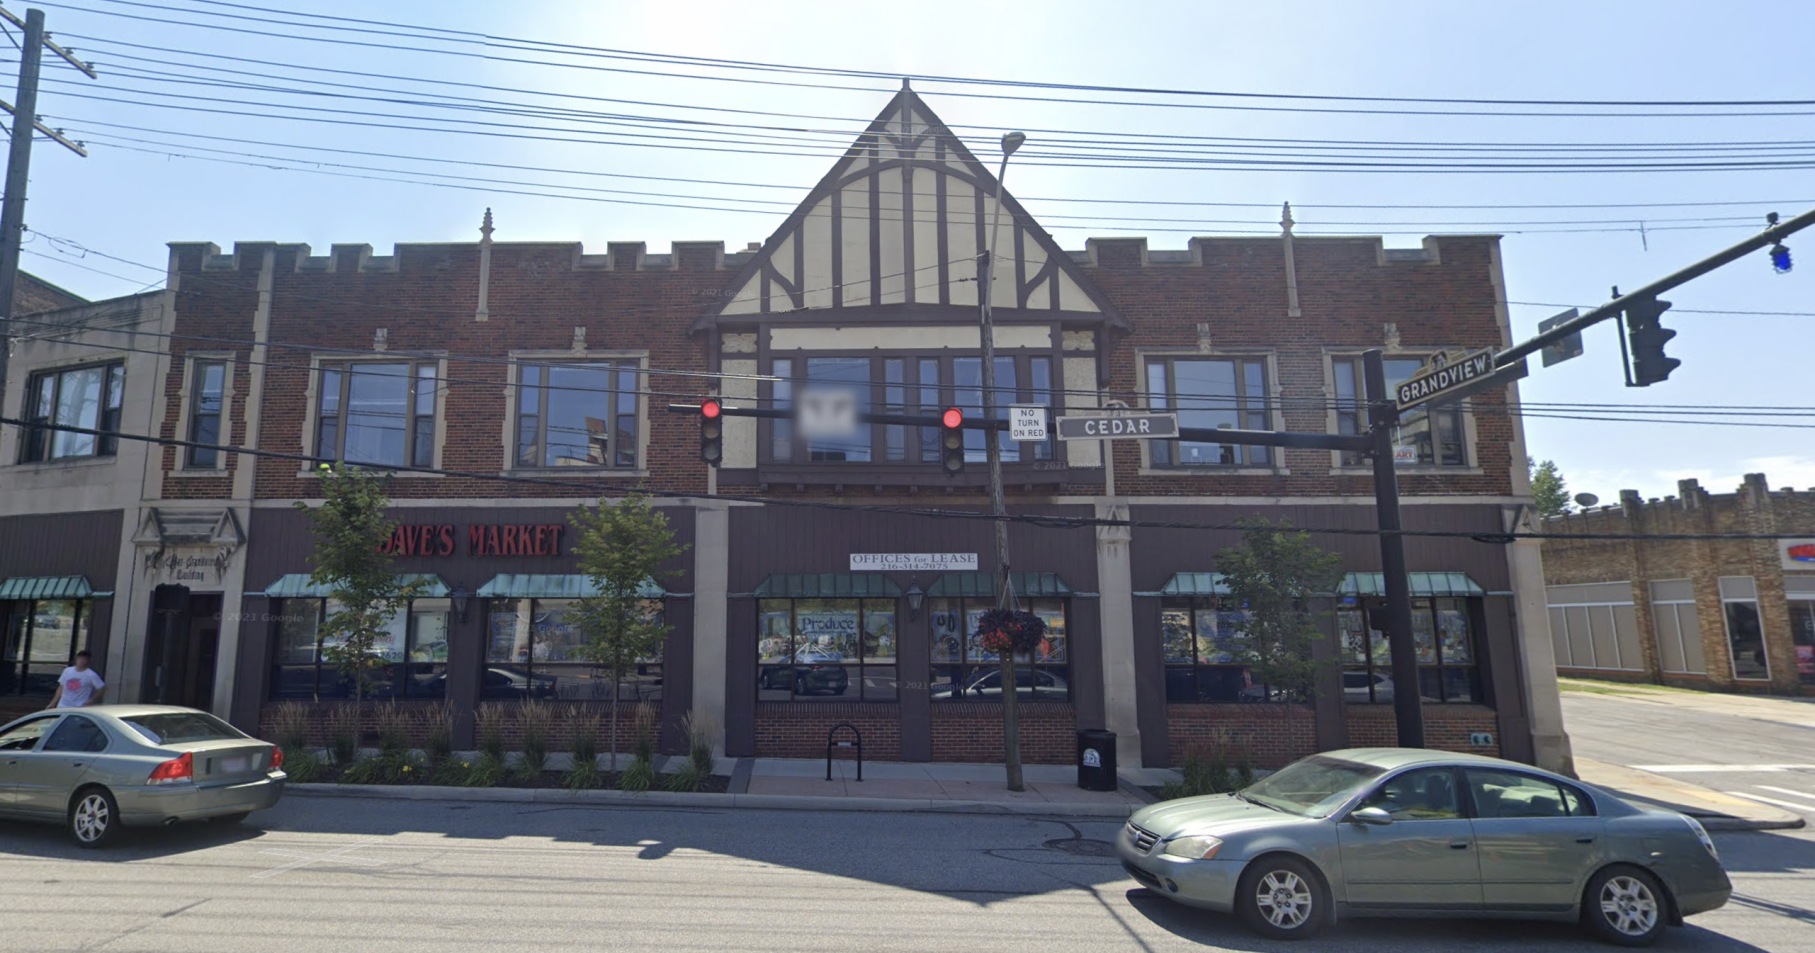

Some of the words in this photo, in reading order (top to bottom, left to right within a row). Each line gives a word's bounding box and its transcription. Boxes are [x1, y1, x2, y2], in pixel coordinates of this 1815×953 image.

[1401, 354, 1486, 402] GRANDVIEW
[1021, 409, 1035, 417] NO
[1018, 419, 1039, 427] TURN
[1085, 419, 1150, 435] CEDAR
[1028, 429, 1044, 437] RED
[468, 524, 563, 557] MARKET
[852, 554, 911, 564] OFFICES
[914, 555, 927, 563] for
[931, 553, 976, 564] LEASE
[802, 617, 854, 630] Produce
